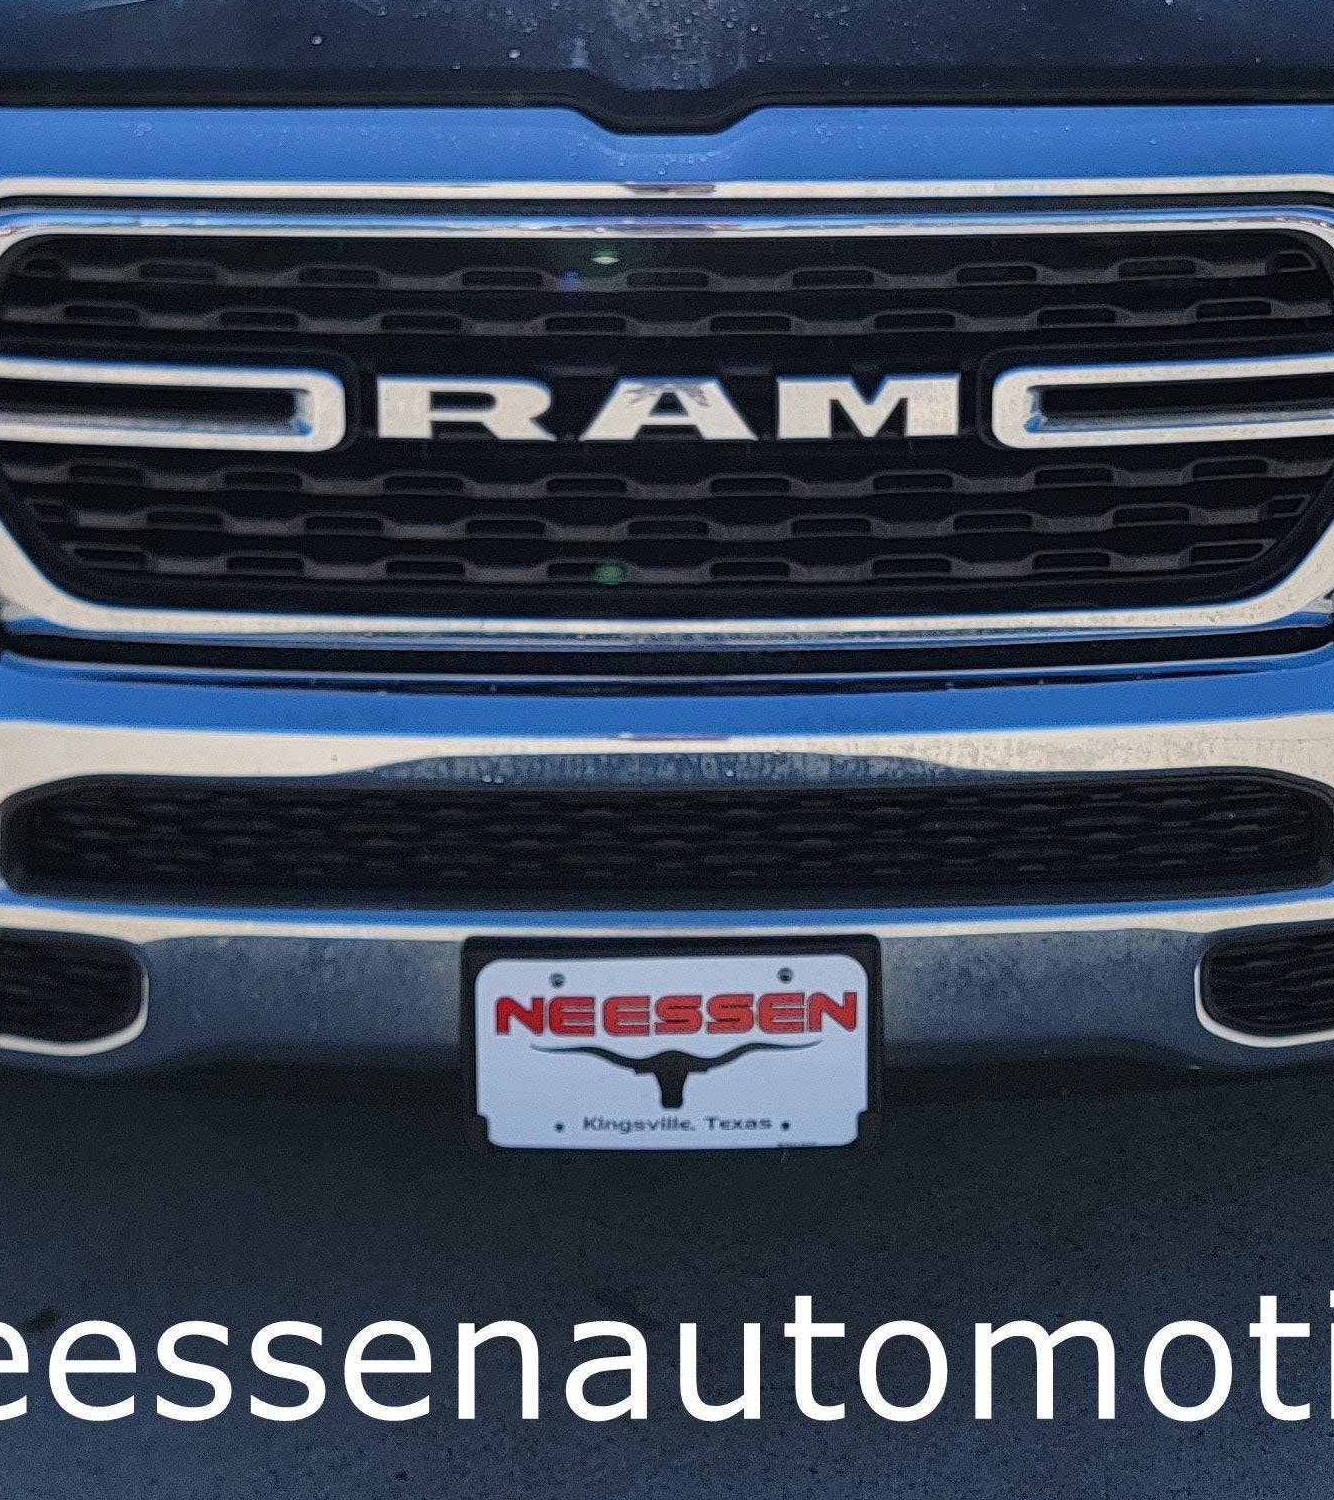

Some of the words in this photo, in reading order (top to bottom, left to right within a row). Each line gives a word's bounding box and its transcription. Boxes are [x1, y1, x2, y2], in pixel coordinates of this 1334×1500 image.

[377, 374, 960, 442] RAM
[495, 991, 858, 1037] NEESSEN
[703, 1116, 773, 1131] Texas
